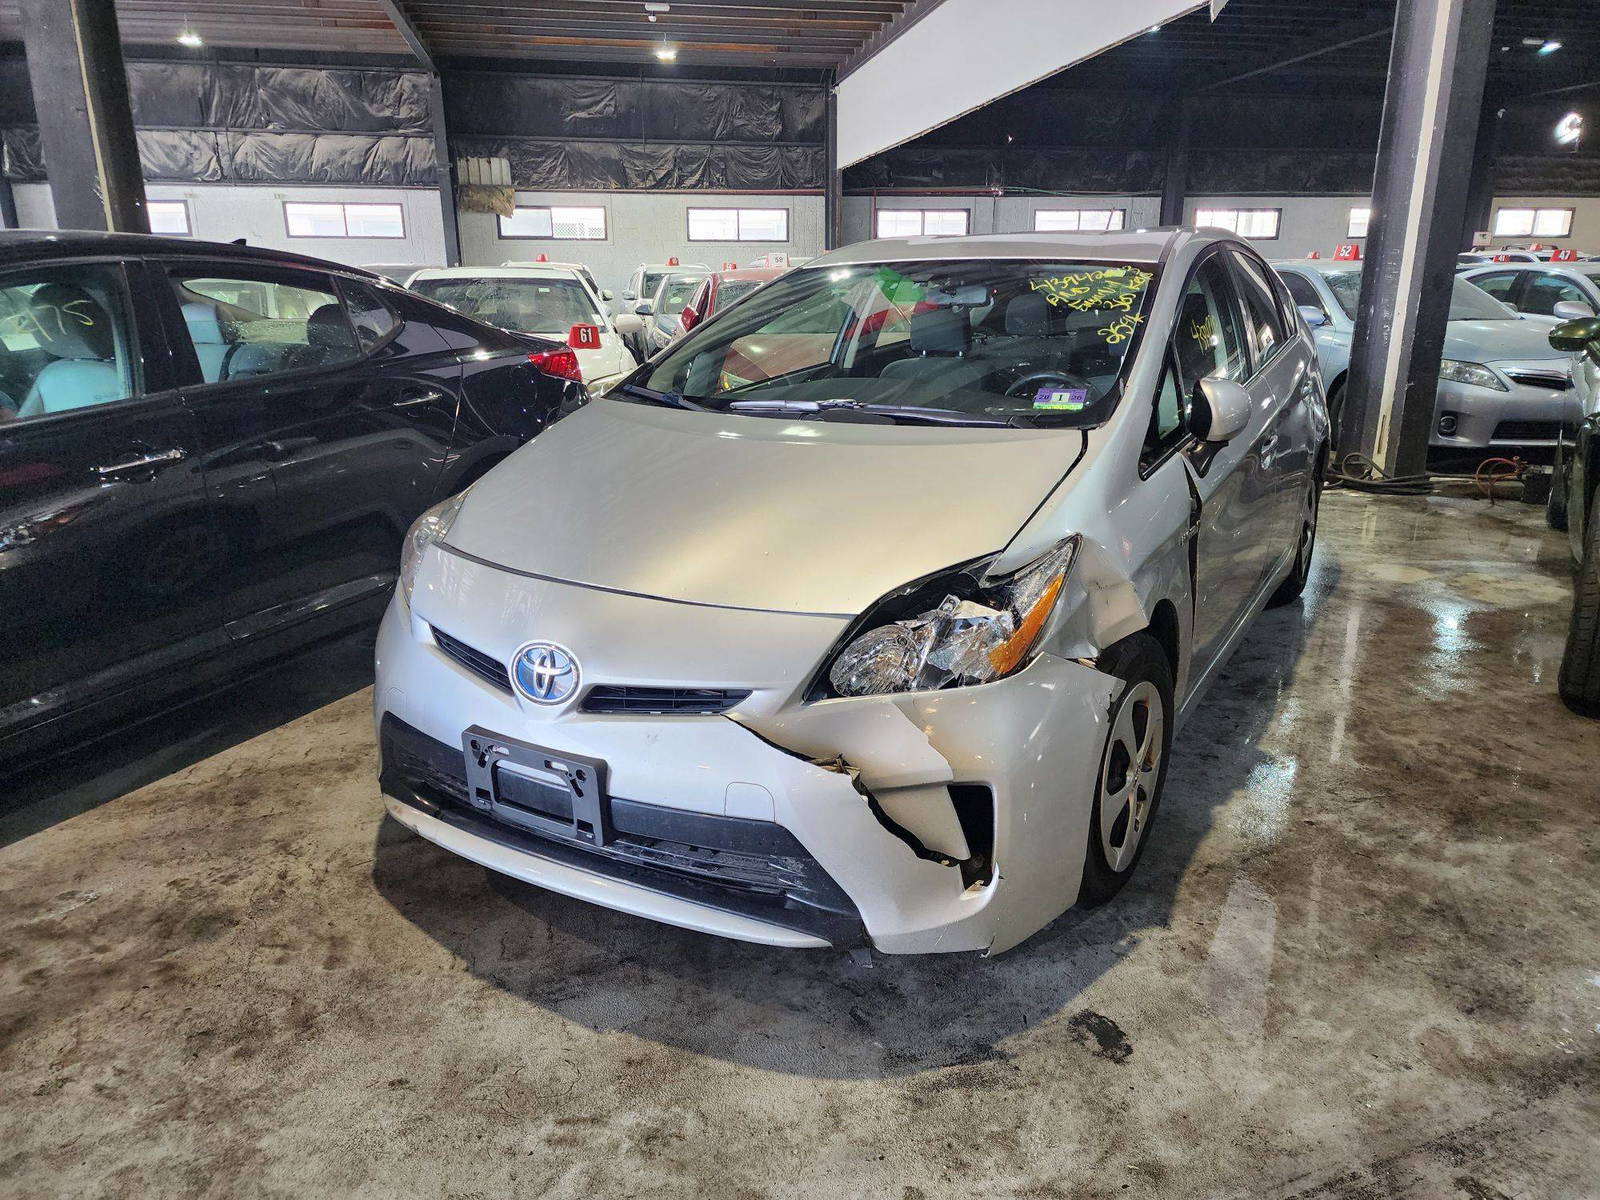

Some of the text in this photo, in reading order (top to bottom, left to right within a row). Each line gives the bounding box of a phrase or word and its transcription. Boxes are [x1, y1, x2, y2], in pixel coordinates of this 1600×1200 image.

[1340, 245, 1352, 257] 52
[1559, 250, 1571, 261] 47
[579, 327, 593, 343] 61
